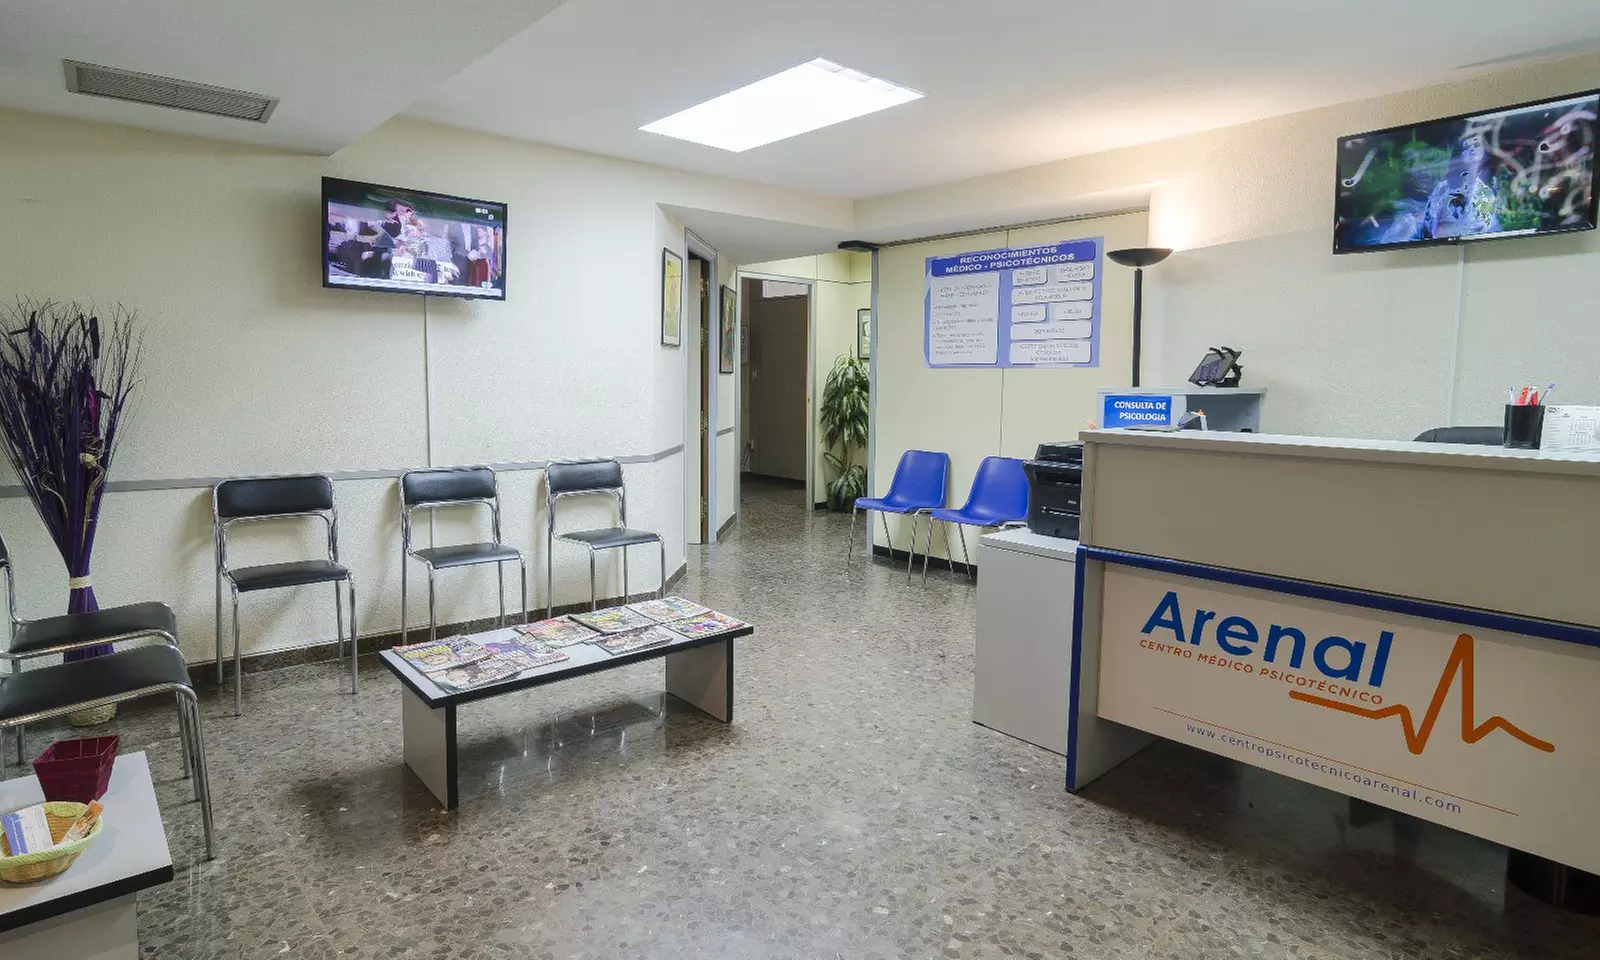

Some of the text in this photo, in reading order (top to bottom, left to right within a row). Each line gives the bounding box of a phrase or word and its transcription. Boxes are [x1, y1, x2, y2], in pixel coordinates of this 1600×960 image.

[945, 263, 982, 274] MÉDICO
[990, 253, 1076, 270] PSICOTÉCNICOS
[960, 246, 1058, 264] RECONOCIMIENTOS
[1114, 400, 1167, 411] CONSULTA DE
[1119, 411, 1167, 421] PSICOLOGIA
[1140, 590, 1394, 688] Arenal
[1139, 639, 1383, 706] CENTRO MÉDICO PSICOTÉCNICO
[1186, 723, 1463, 815] www.centropsicotecnicoarenal.com
